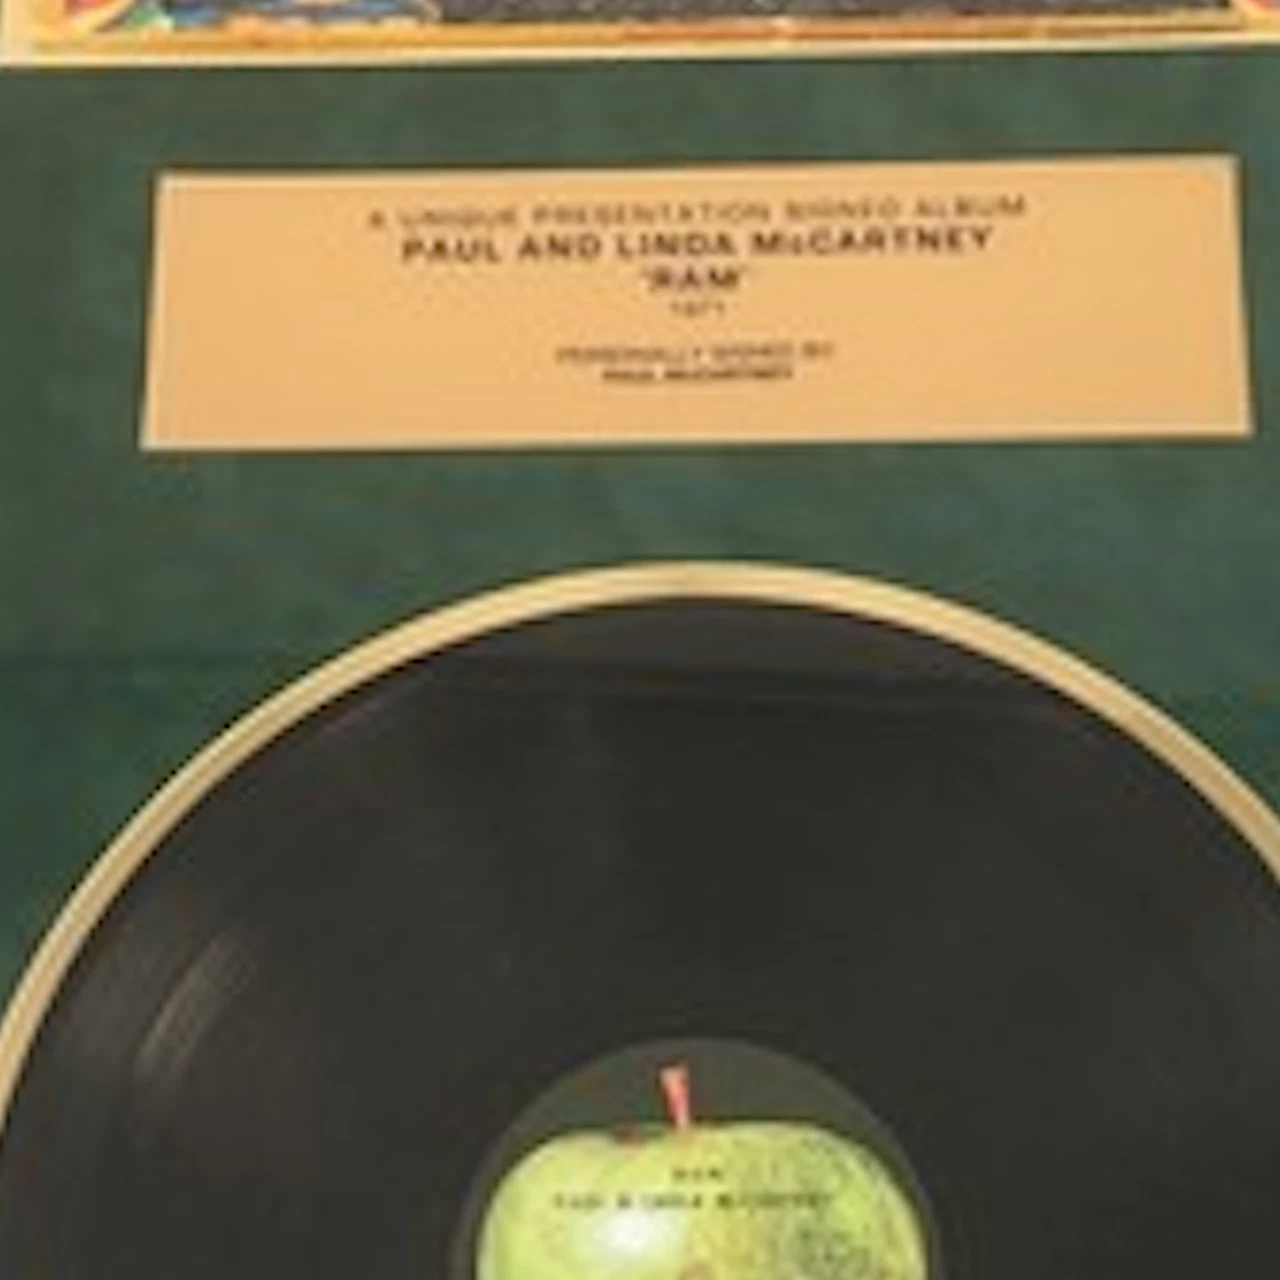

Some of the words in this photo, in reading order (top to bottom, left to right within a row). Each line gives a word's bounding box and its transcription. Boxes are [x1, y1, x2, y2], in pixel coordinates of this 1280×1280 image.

[399, 206, 517, 228] UNIQUE
[532, 201, 771, 225] PRESENTATION
[785, 197, 902, 220] SIGNED
[915, 194, 1025, 218] ALBUM
[401, 237, 500, 263] PAUL
[518, 231, 602, 260] AND
[616, 227, 738, 258] LINDA
[749, 224, 994, 257] McCARTNEY
